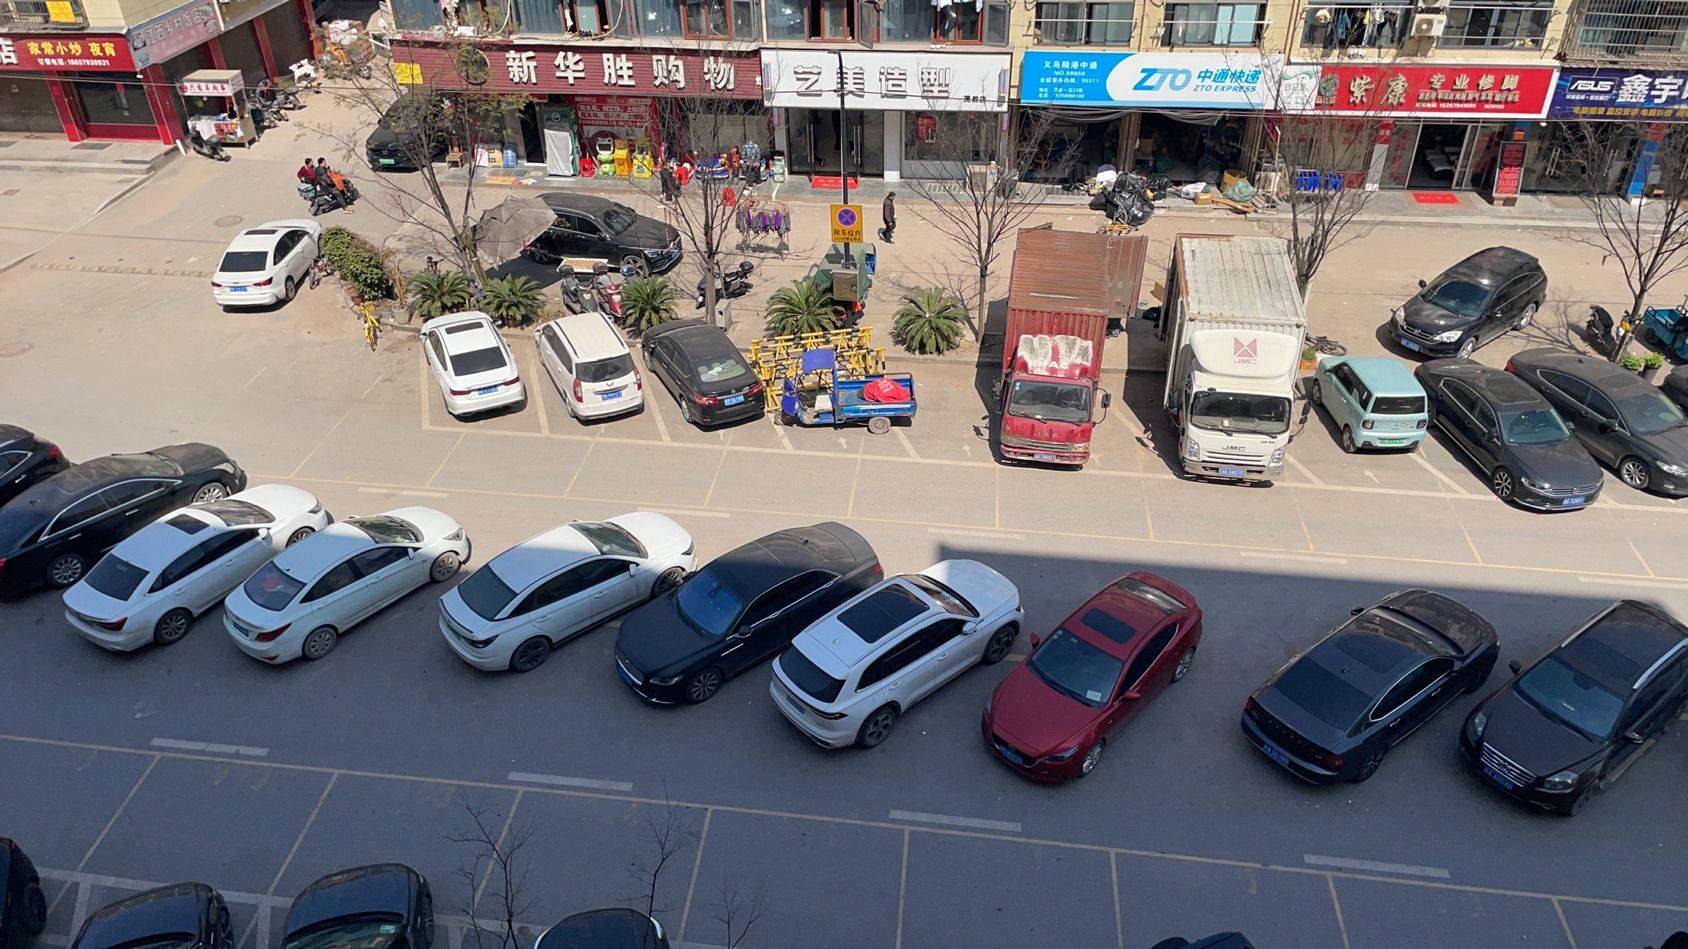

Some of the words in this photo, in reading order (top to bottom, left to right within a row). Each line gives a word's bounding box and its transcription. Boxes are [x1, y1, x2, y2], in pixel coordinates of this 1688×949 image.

[27, 41, 82, 56] 家常小炒
[88, 42, 116, 56] 夜宵
[505, 50, 736, 90] 新华胜购物
[1197, 68, 1263, 84] 中通快递
[793, 65, 952, 100] 艺美造型
[1133, 68, 1192, 92] ZTO
[1193, 84, 1212, 92] ZTO
[1214, 84, 1257, 93] EXPRESS
[1429, 74, 1520, 91] 专业修脚
[1570, 80, 1615, 91] ASUS
[1615, 74, 1688, 104] 鑫宇
